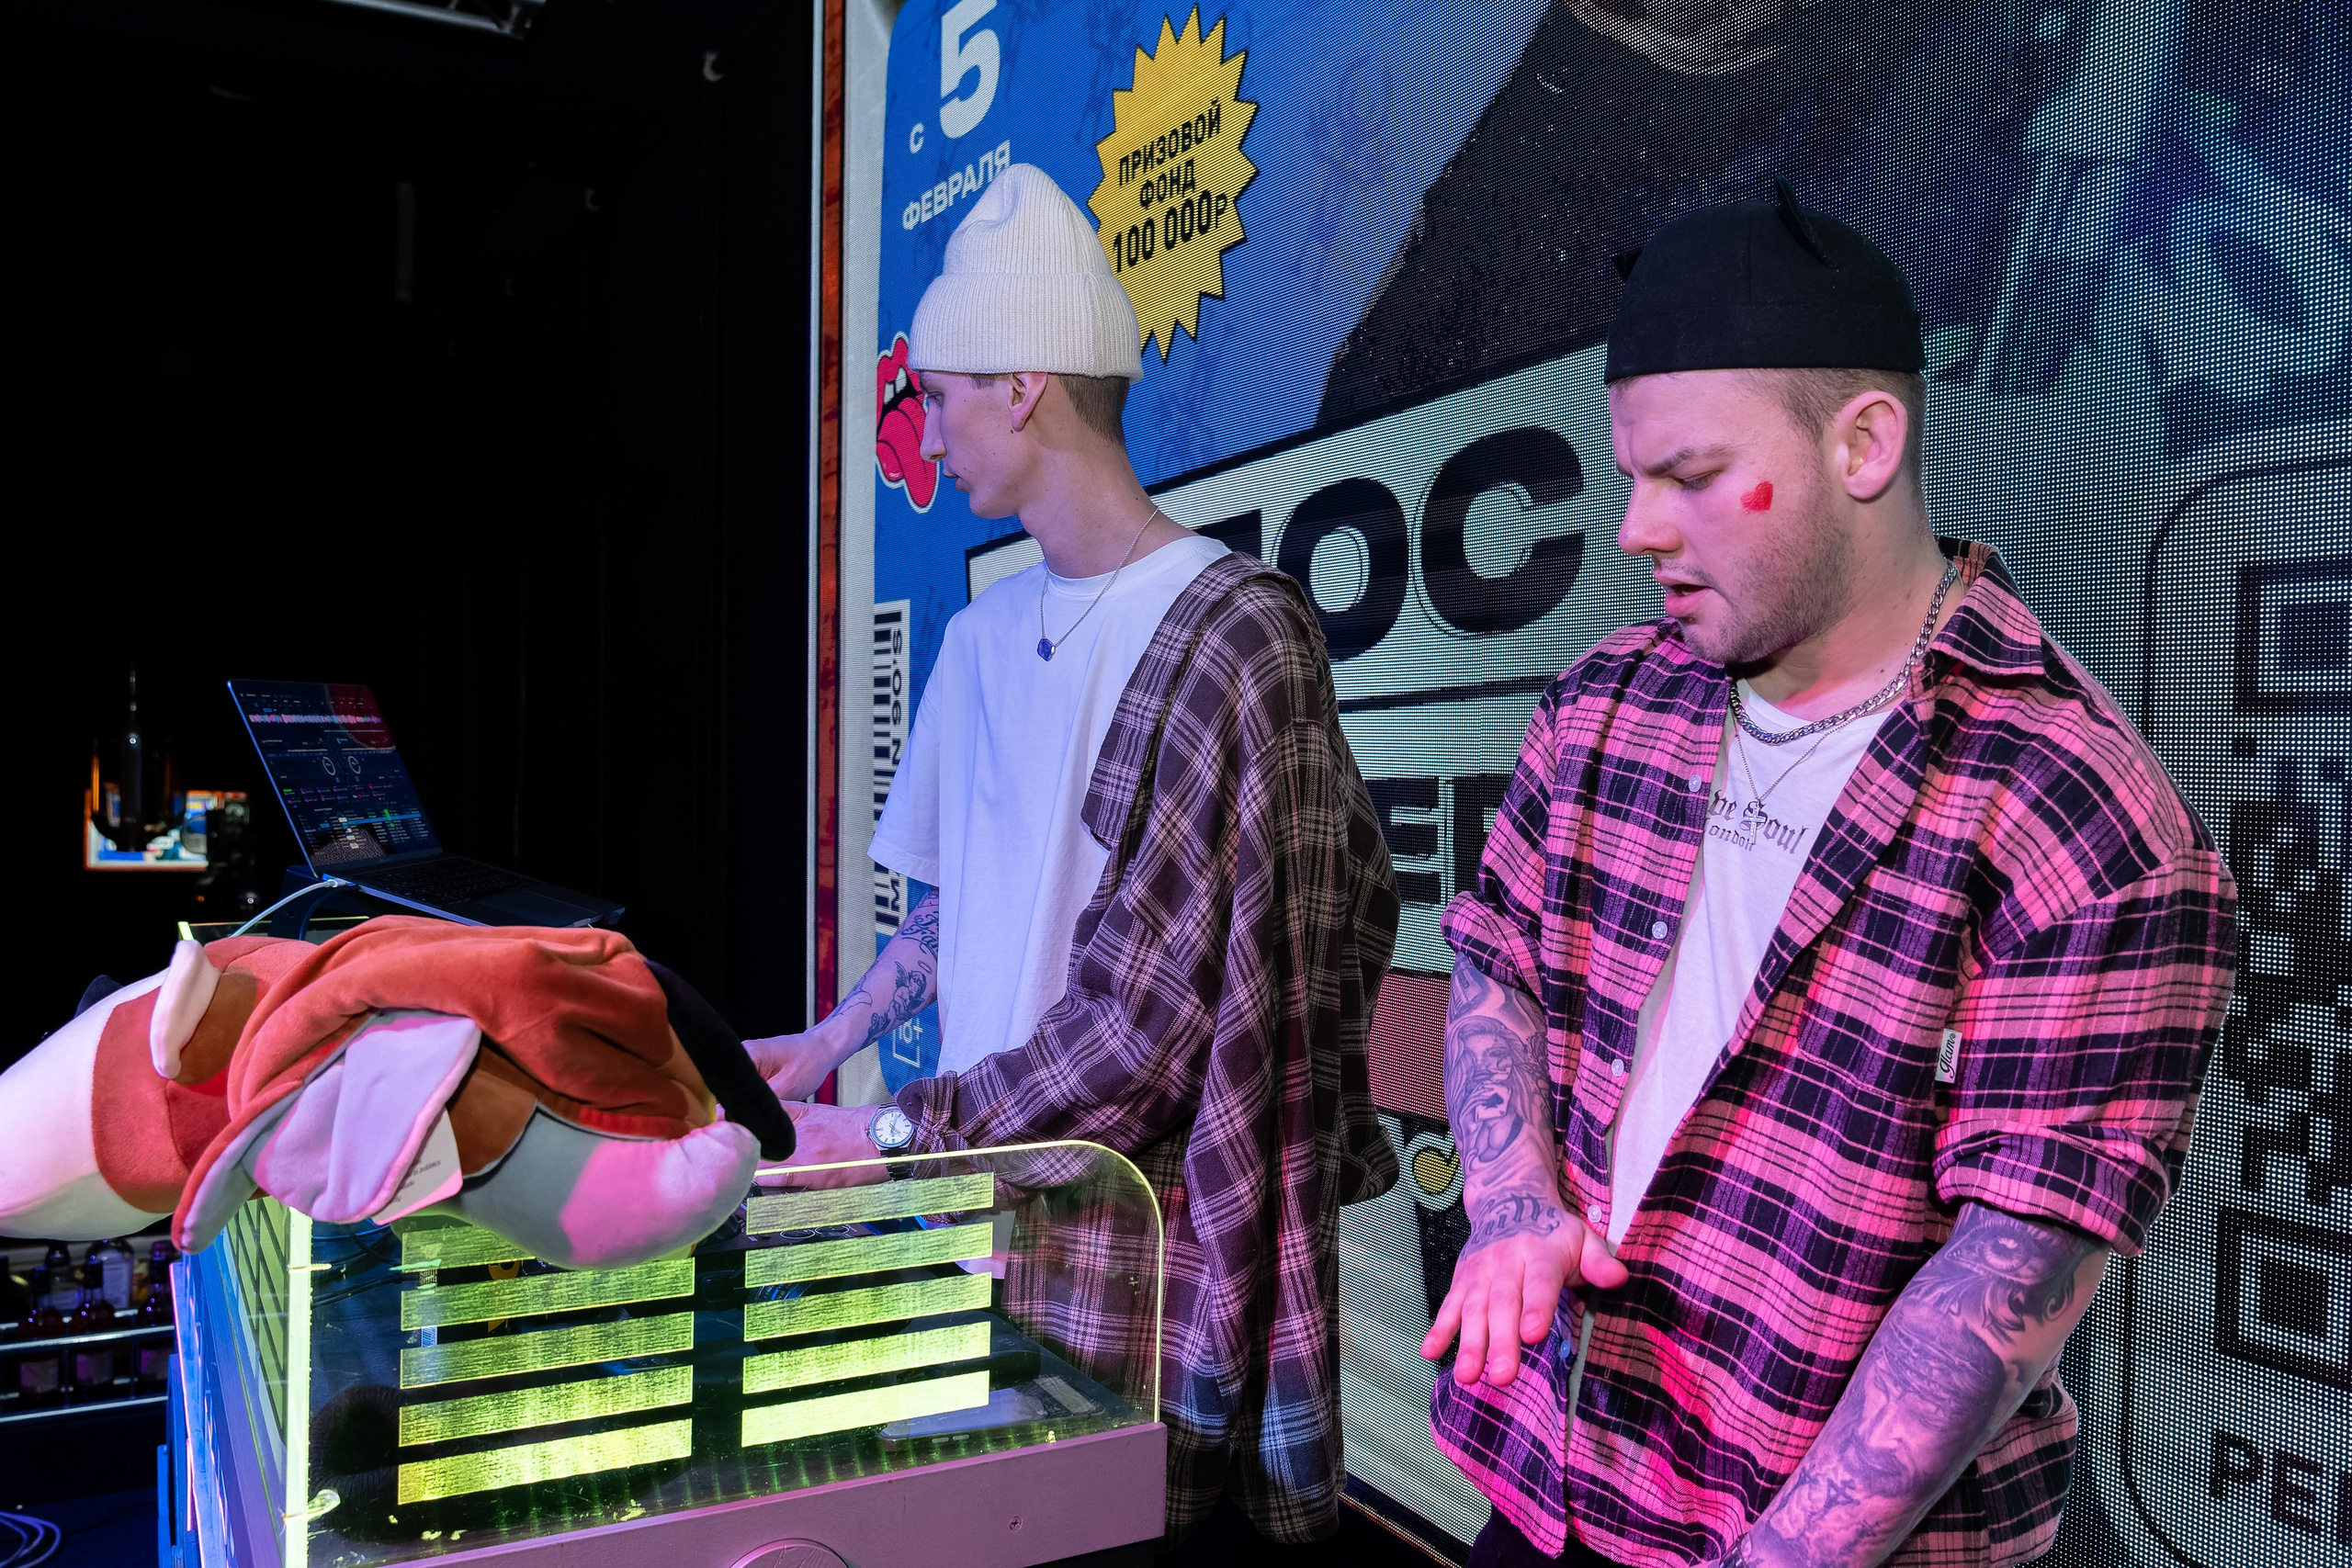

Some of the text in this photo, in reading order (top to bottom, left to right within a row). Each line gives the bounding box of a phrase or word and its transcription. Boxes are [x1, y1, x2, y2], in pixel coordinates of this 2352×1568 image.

[939, 0, 1001, 139] 5
[1119, 97, 1221, 186] ПРИЗОВОЙ
[902, 140, 1011, 230] ФЕВРАЛЯ
[1140, 158, 1195, 209] ФОНД
[1113, 217, 1155, 273] 100
[892, 628, 902, 725] 90'S
[1707, 823, 1754, 852] ondon
[1739, 800, 1809, 854] Soul
